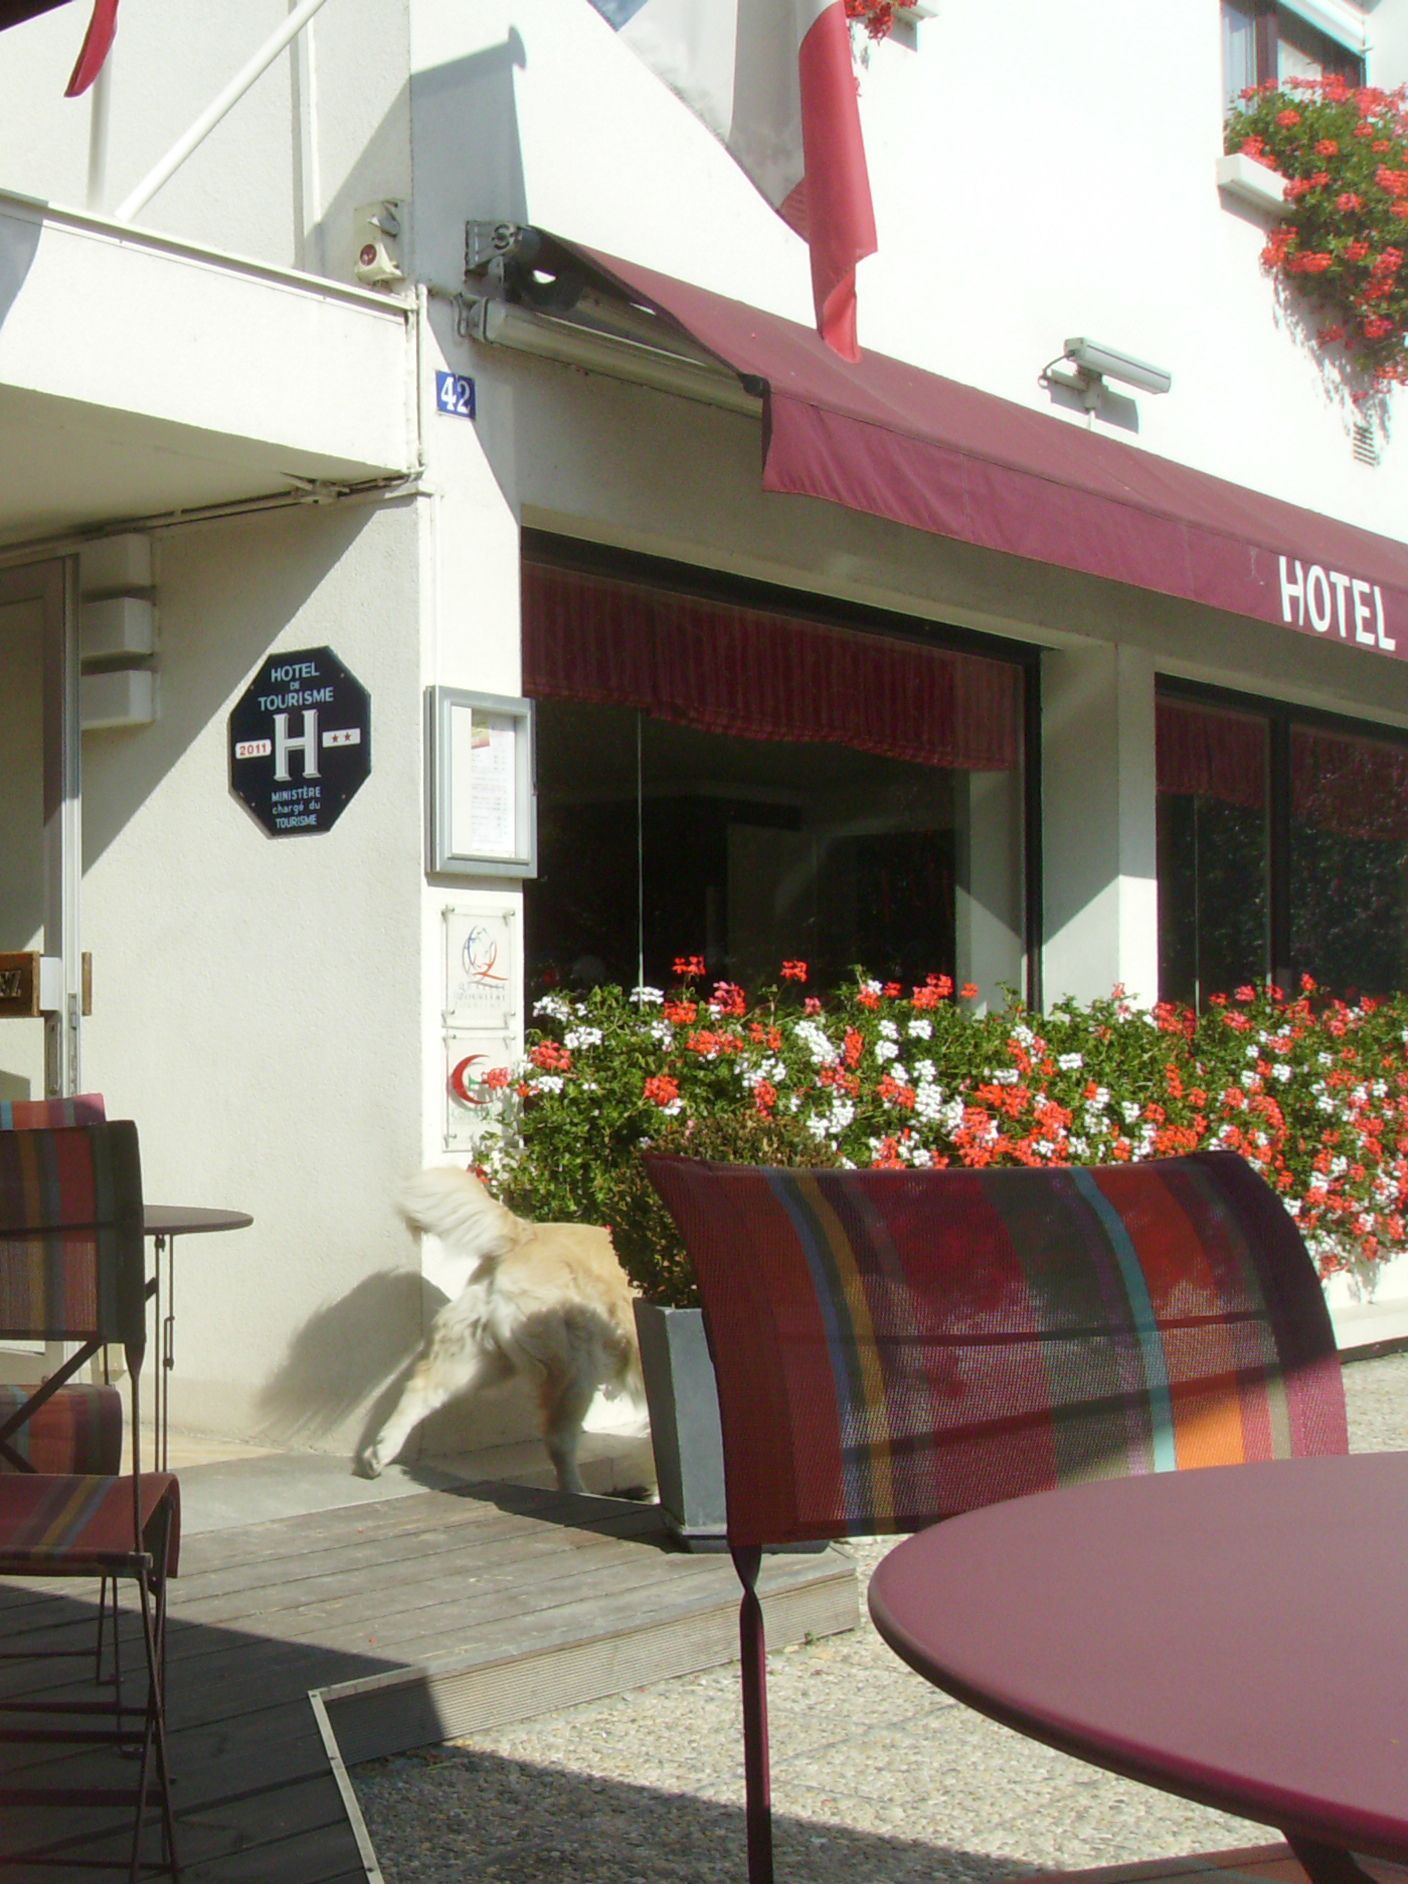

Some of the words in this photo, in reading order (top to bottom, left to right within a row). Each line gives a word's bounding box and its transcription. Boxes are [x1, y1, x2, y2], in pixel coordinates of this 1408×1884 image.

[440, 376, 471, 414] 42
[1279, 555, 1396, 652] HOTEL
[271, 662, 321, 683] HOTEL
[289, 681, 301, 689] DE
[258, 687, 335, 711] TOURISME
[239, 743, 269, 756] 2011
[273, 709, 322, 781] H
[271, 786, 322, 802] MINISTÈRE
[272, 801, 305, 815] chargé
[308, 799, 321, 810] du
[276, 814, 317, 828] TOURISME
